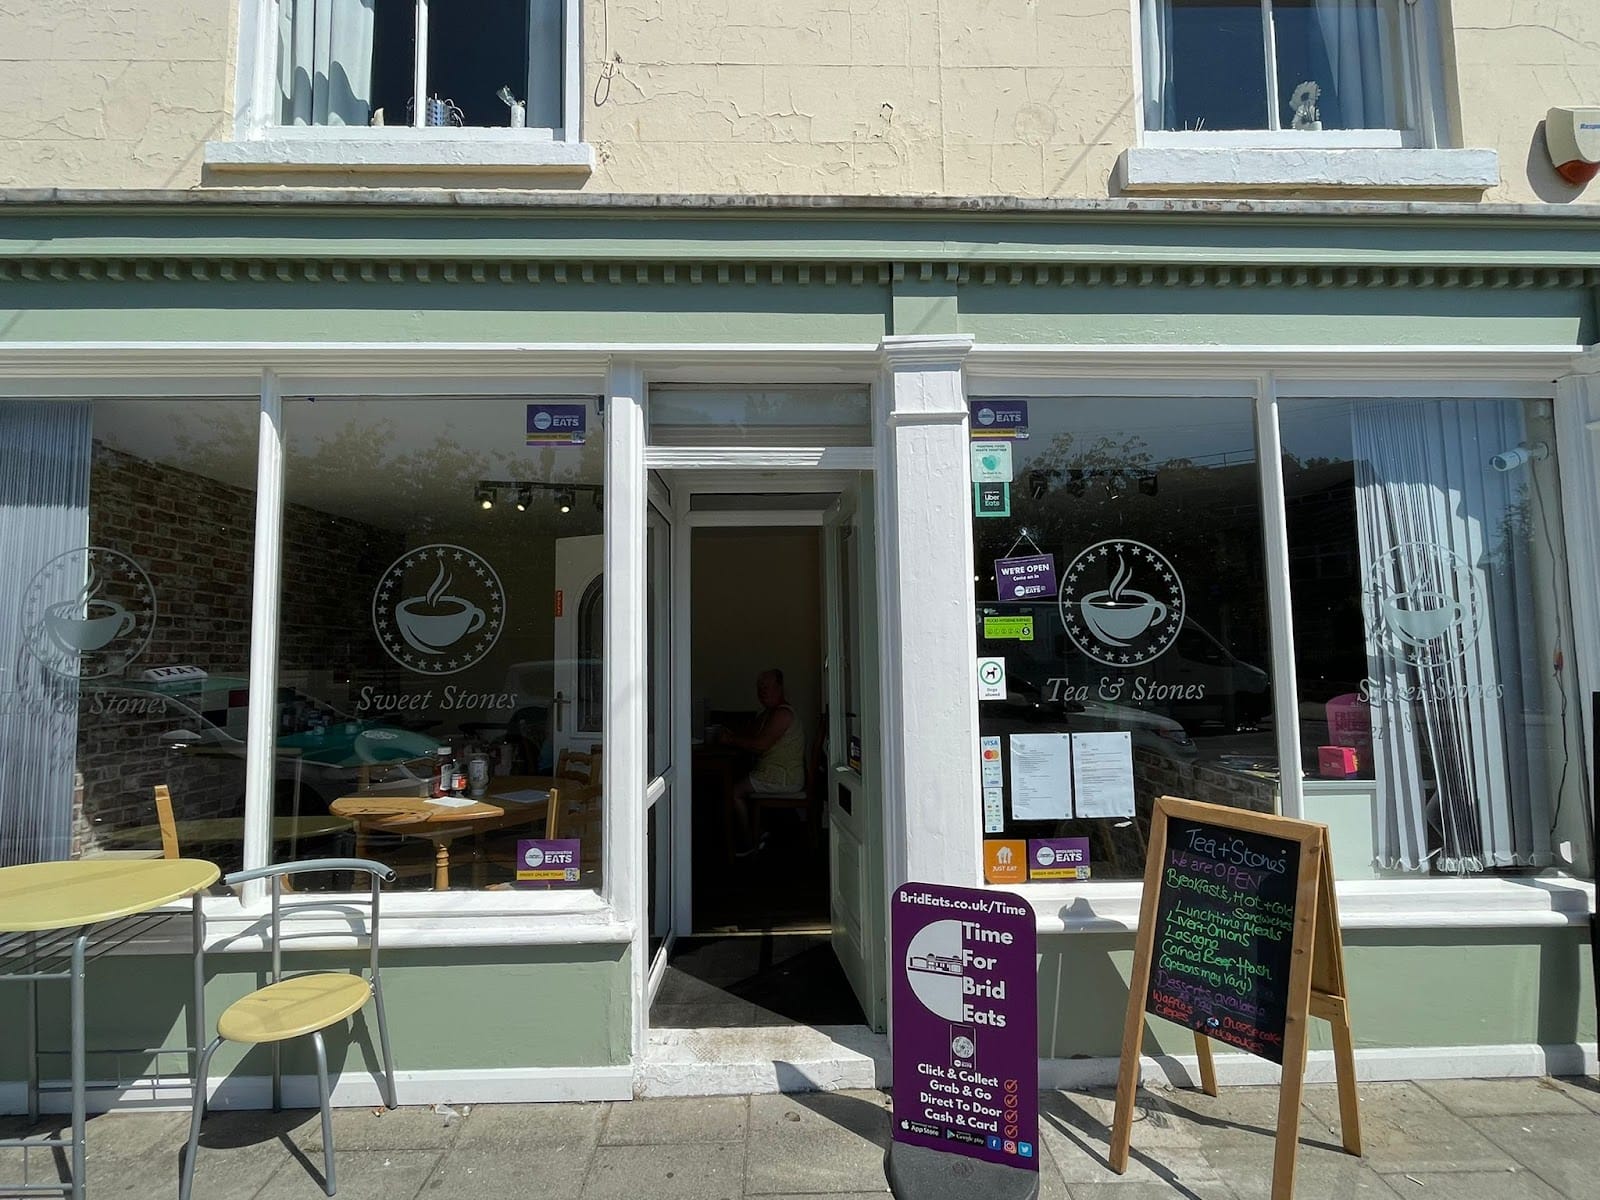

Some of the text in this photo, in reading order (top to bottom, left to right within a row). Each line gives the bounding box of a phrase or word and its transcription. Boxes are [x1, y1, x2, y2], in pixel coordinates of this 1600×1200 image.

[552, 418, 579, 427] EATS
[996, 414, 1021, 422] EATS
[1001, 563, 1050, 576] WE'RE OPEN
[356, 684, 518, 711] Sweet Stones
[1046, 676, 1205, 702] Tea & Stones
[88, 692, 168, 715] Stones
[544, 855, 573, 864] EATS
[1055, 853, 1083, 862] EATS
[1171, 849, 1262, 890] We are OPEN
[900, 891, 1027, 916] BridEats.co.uk/Time
[1175, 899, 1283, 941] Lunchtime Meals
[962, 921, 1013, 945] Time
[962, 949, 997, 970] For
[962, 976, 1006, 1000] Brid
[962, 1004, 1007, 1028] Eats
[917, 1063, 945, 1078] Click
[947, 1068, 957, 1080] &
[958, 1071, 999, 1088] Collect
[929, 1079, 992, 1101] Grab & Go
[920, 1092, 1002, 1118] Direct To Door
[924, 1108, 953, 1124] Cash
[955, 1117, 966, 1126] &
[967, 1116, 998, 1133] Card
